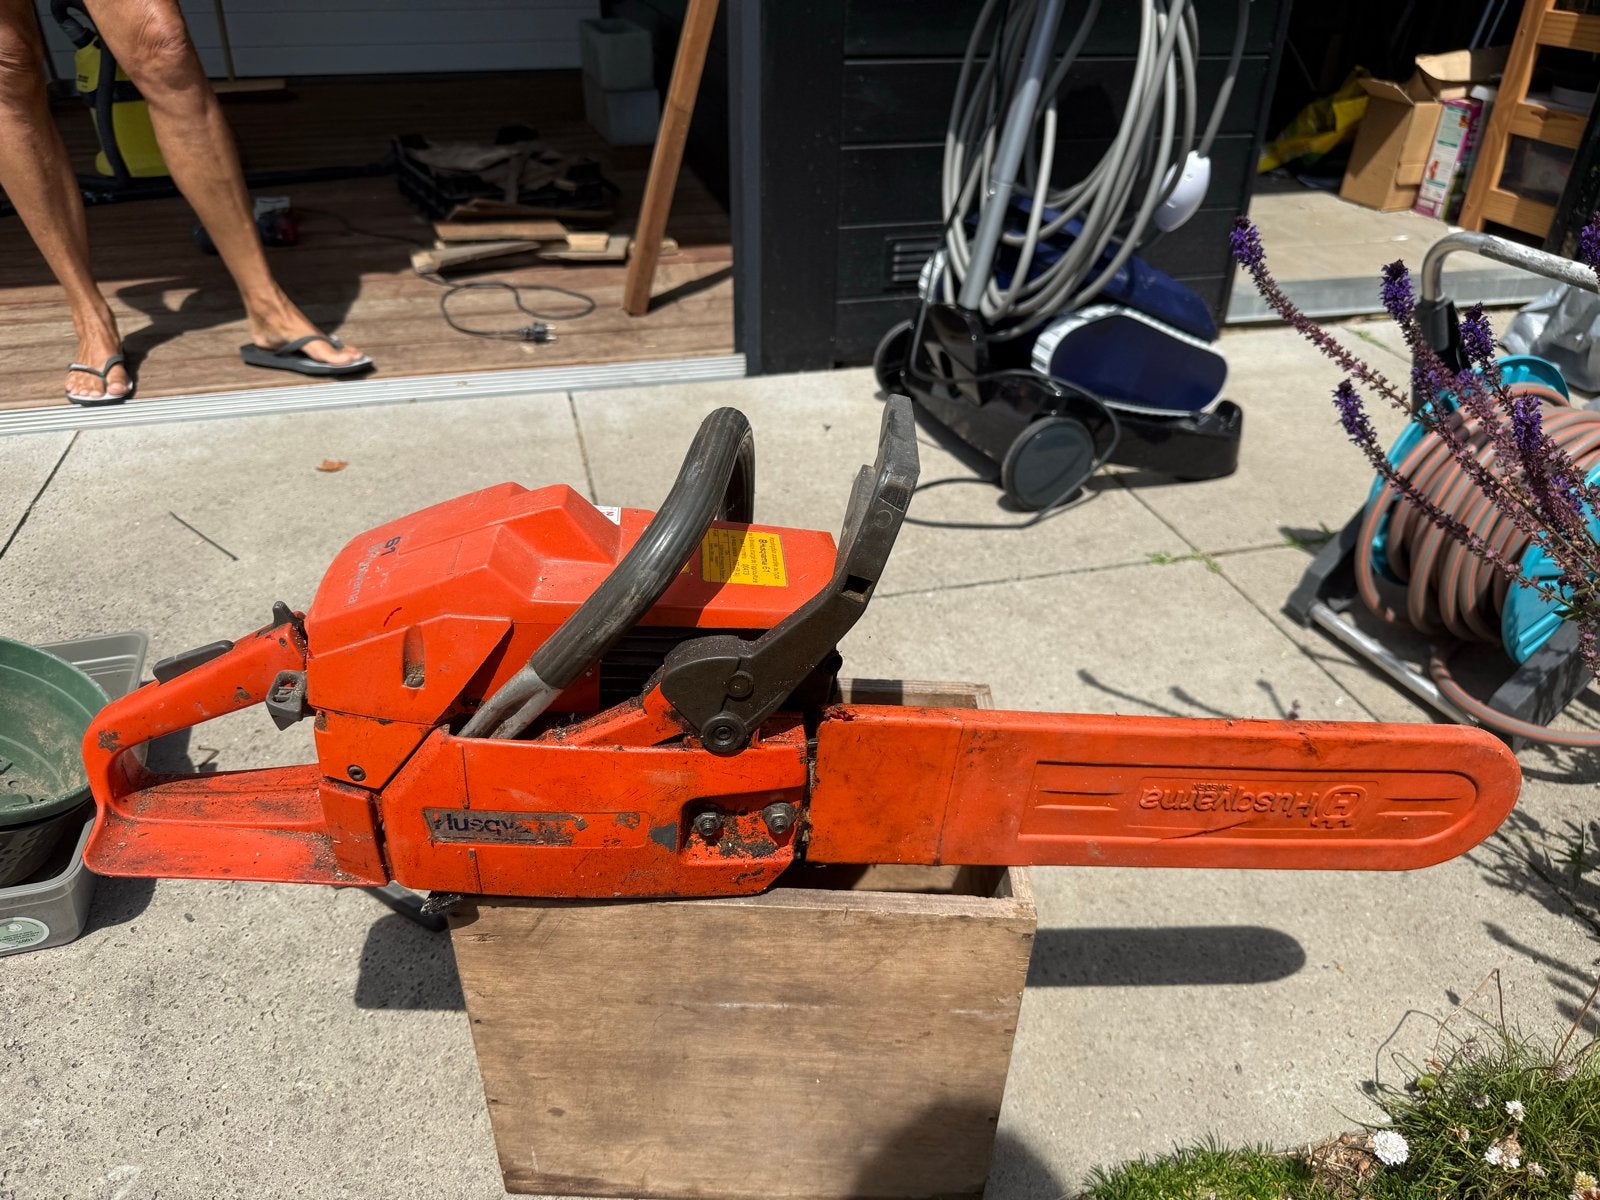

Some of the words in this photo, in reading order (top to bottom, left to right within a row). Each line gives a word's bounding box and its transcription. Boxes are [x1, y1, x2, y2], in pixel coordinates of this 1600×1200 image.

[381, 536, 401, 556] 61
[1193, 782, 1233, 792] SWEDEN
[1139, 785, 1320, 818] Husqvarna
